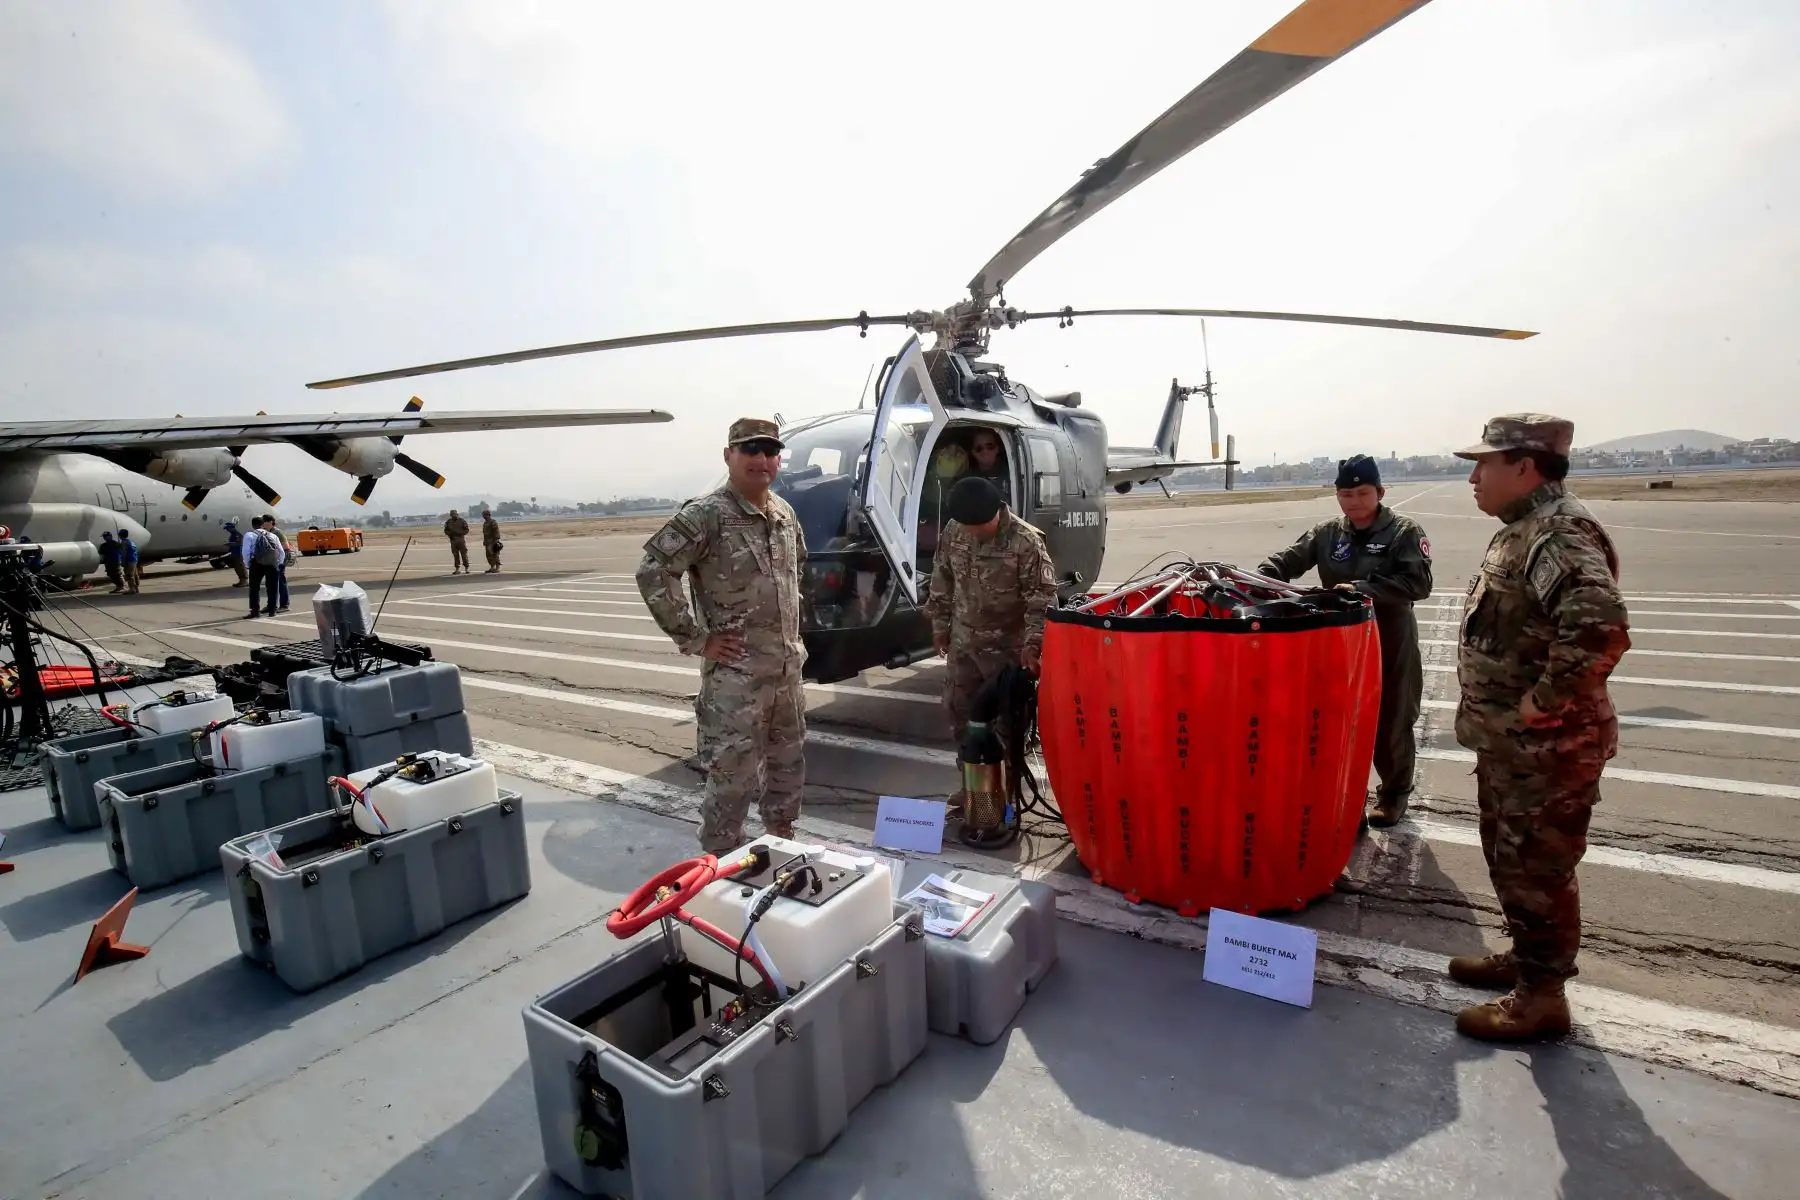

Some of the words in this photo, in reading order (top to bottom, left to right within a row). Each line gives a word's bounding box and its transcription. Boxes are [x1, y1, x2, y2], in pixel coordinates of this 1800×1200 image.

[1073, 512, 1084, 527] DEL
[1085, 511, 1099, 526] PERU
[1074, 695, 1085, 748] BAMBI
[1109, 708, 1121, 764] BAMBI
[1177, 712, 1189, 769] BAMBI
[1247, 716, 1259, 777] BAMBI
[1224, 936, 1250, 949] BAMBI
[1251, 943, 1276, 956] BUKET
[1278, 950, 1297, 961] MAX
[1249, 955, 1268, 967] 2732
